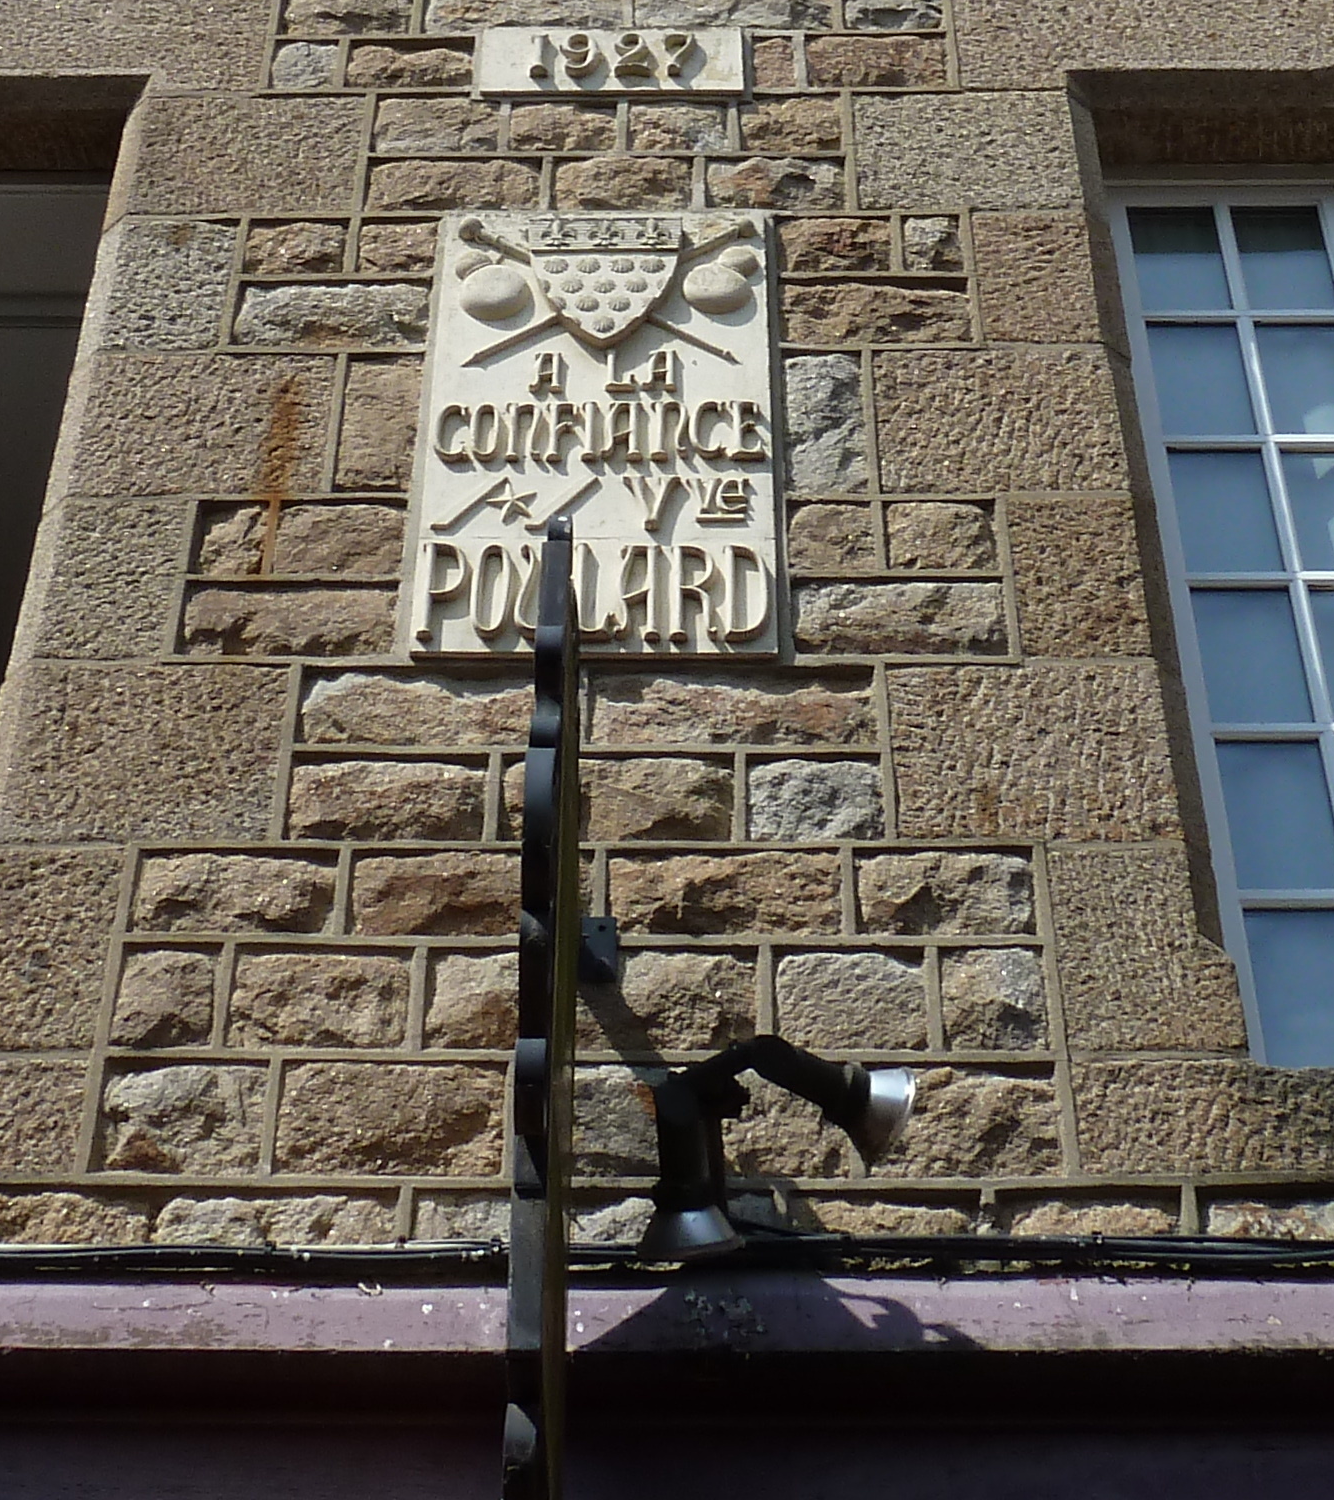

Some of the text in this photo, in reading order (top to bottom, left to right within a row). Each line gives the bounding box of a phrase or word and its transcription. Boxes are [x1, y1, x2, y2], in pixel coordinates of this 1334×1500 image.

[529, 32, 695, 79] 1927
[528, 349, 677, 393] A LA
[434, 400, 766, 463] CONFIANCE
